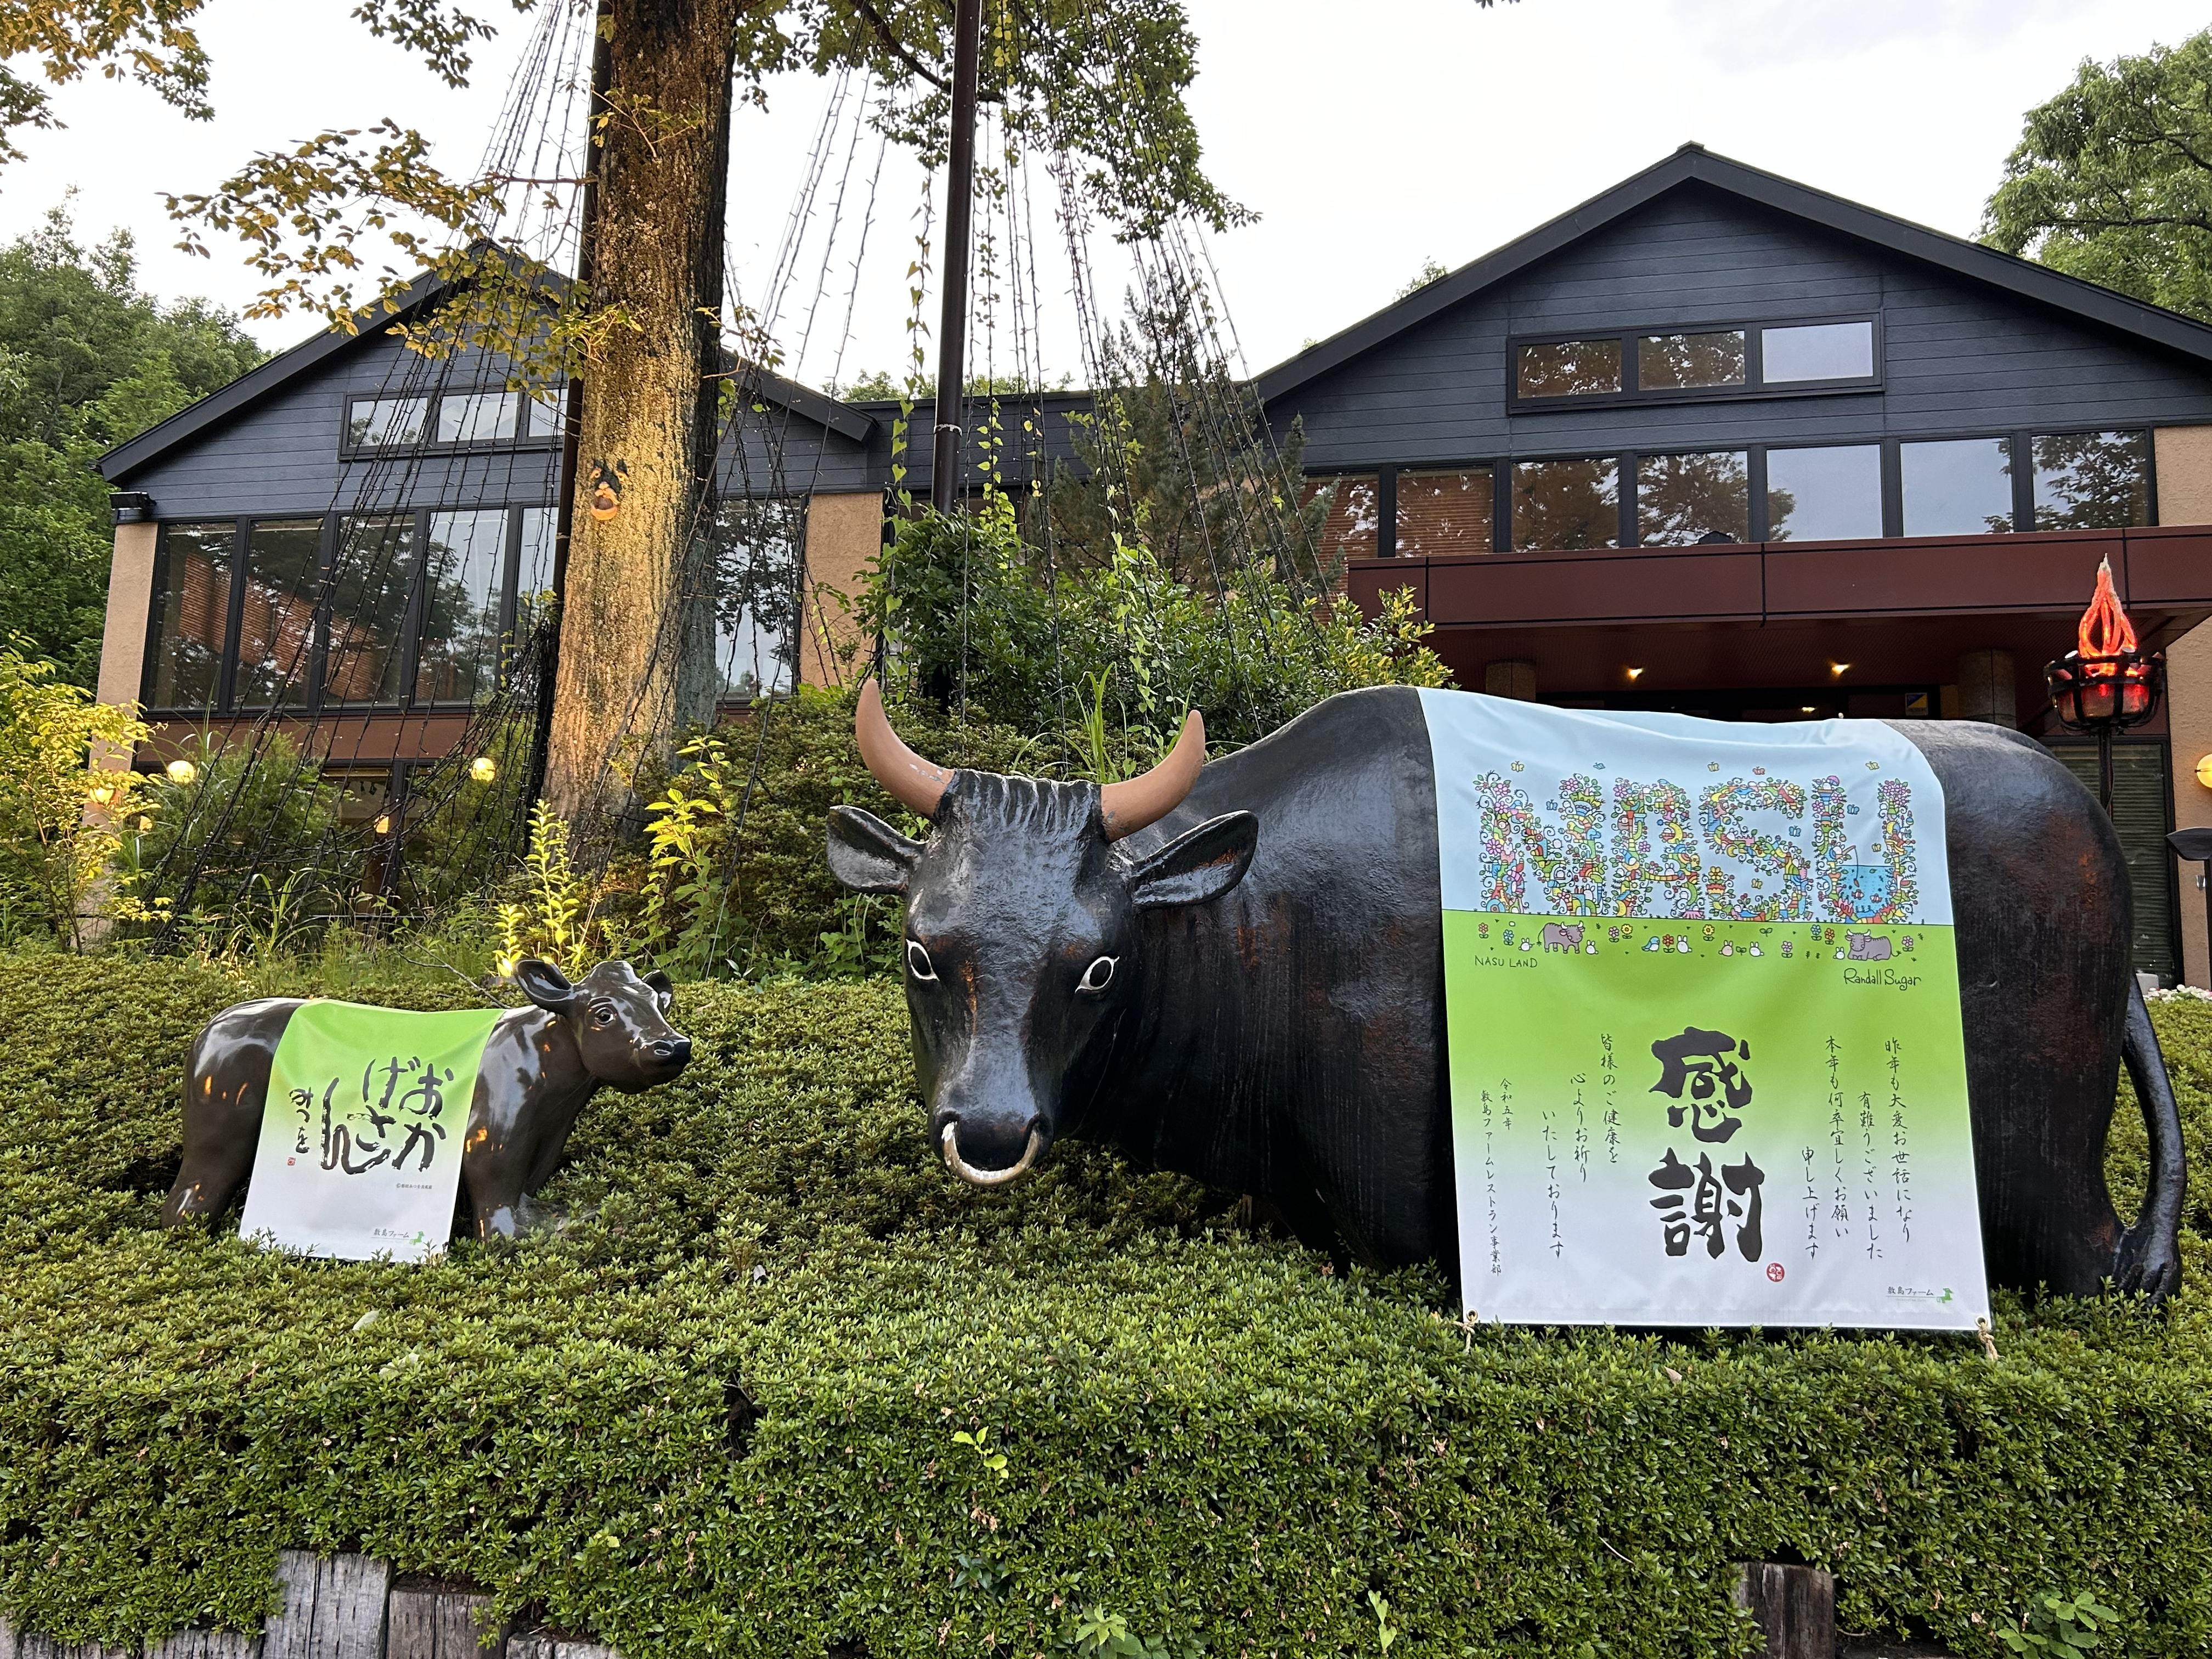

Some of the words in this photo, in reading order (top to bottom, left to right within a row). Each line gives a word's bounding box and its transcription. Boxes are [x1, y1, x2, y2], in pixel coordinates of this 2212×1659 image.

[1474, 771, 1918, 924] NASU
[1474, 955, 1505, 967] NASU
[1509, 957, 1538, 968] LAND
[1843, 967, 1882, 985] Randall
[1884, 968, 1922, 991] Sugar
[1499, 1077, 1514, 1131] 令和五年
[1570, 1071, 1590, 1183] 心よりお祈り
[1600, 1032, 1622, 1164] 皆様のご健康を
[1647, 1026, 1765, 1263] 感謝
[1825, 1035, 1849, 1238] 本年も何卒宜しくお願い
[1884, 1036, 1912, 1243] 昨年も大変お世話になり
[1480, 1089, 1502, 1277] 敷島ファームレストラン事業部
[1542, 1110, 1565, 1260] いたしております
[1802, 1146, 1820, 1260] 申し上げます
[1858, 1091, 1883, 1260] 有難うございました
